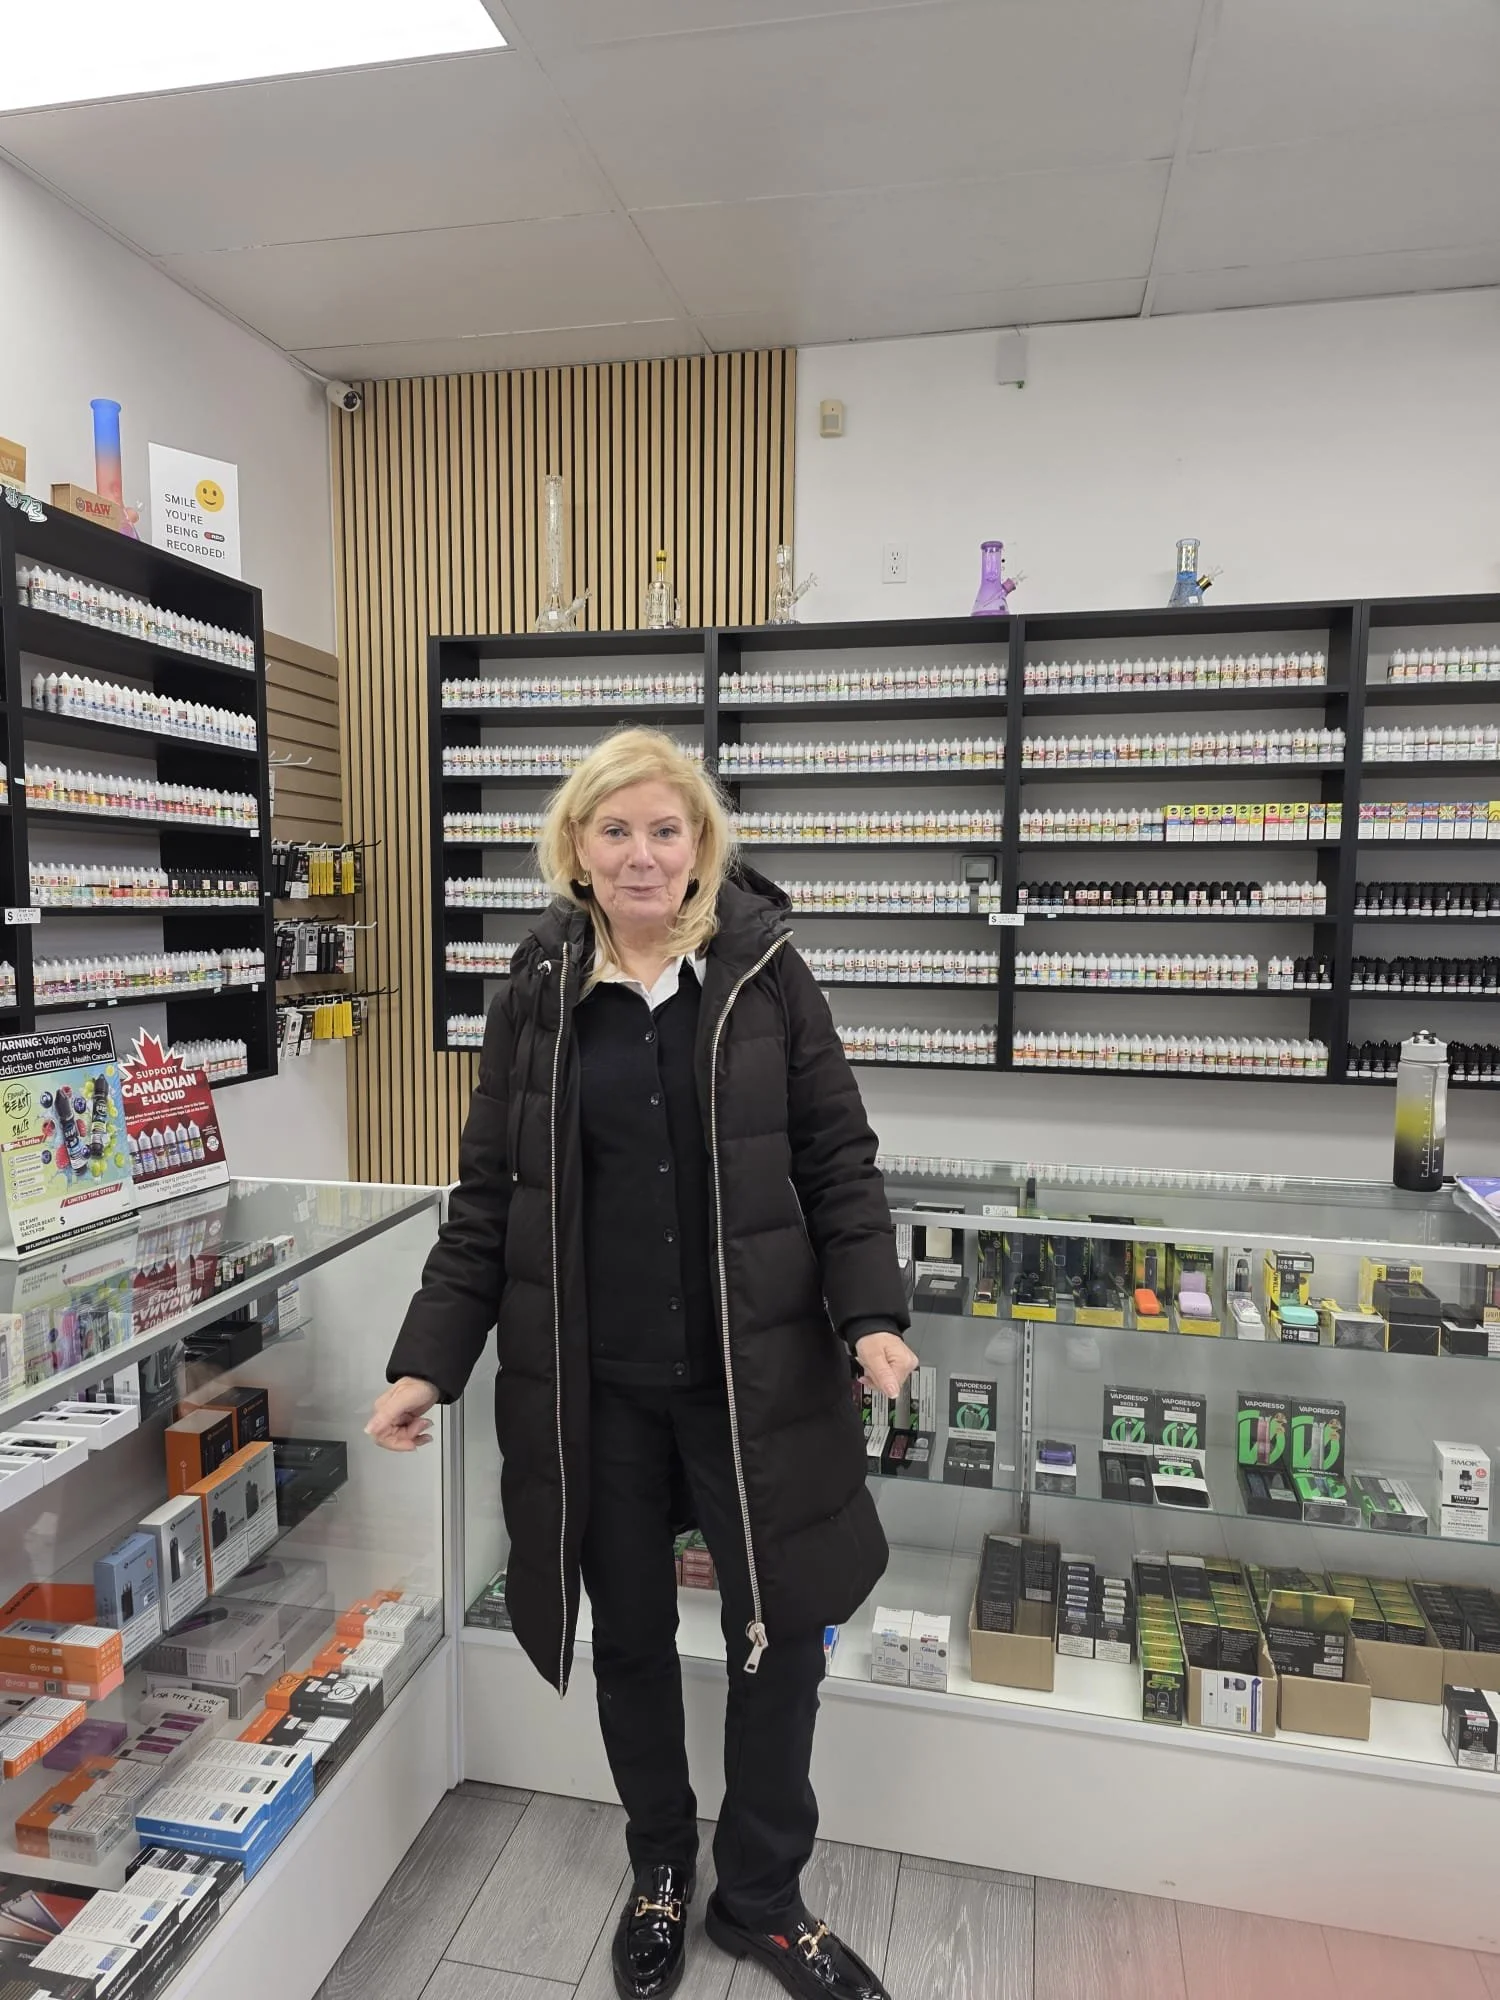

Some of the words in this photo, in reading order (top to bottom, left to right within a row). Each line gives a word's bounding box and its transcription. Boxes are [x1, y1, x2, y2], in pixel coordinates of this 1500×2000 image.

[85, 500, 111, 515] RAW
[165, 493, 196, 508] SMILE
[165, 508, 203, 525] YOU'RE
[166, 524, 198, 539] BEING
[167, 540, 225, 559] RECORDED!
[0, 1038, 42, 1051] ARNING:
[42, 1034, 71, 1045] Vaping
[72, 1029, 107, 1041] products
[2, 1051, 34, 1063] contain
[36, 1046, 71, 1057] nicotine,
[78, 1041, 102, 1053] highly
[35, 1056, 72, 1070] chemical.
[73, 1055, 91, 1064] Health
[92, 1052, 113, 1062] Canada
[136, 1065, 178, 1080] SUPPORT
[121, 1073, 197, 1098] CANADIAN
[3, 1093, 31, 1114] BEAST
[142, 1090, 185, 1106] E-LIQUID
[12, 1119, 30, 1137] SALTS
[60, 1216, 66, 1225] $
[1179, 1252, 1209, 1261] UWELL
[956, 1381, 992, 1391] VAPORESSO
[1110, 1393, 1148, 1402] VAPORESSO
[1161, 1398, 1201, 1408] VAPORESSO
[1245, 1400, 1285, 1410] VAPORESSO
[1299, 1405, 1340, 1416] VAPORESSO
